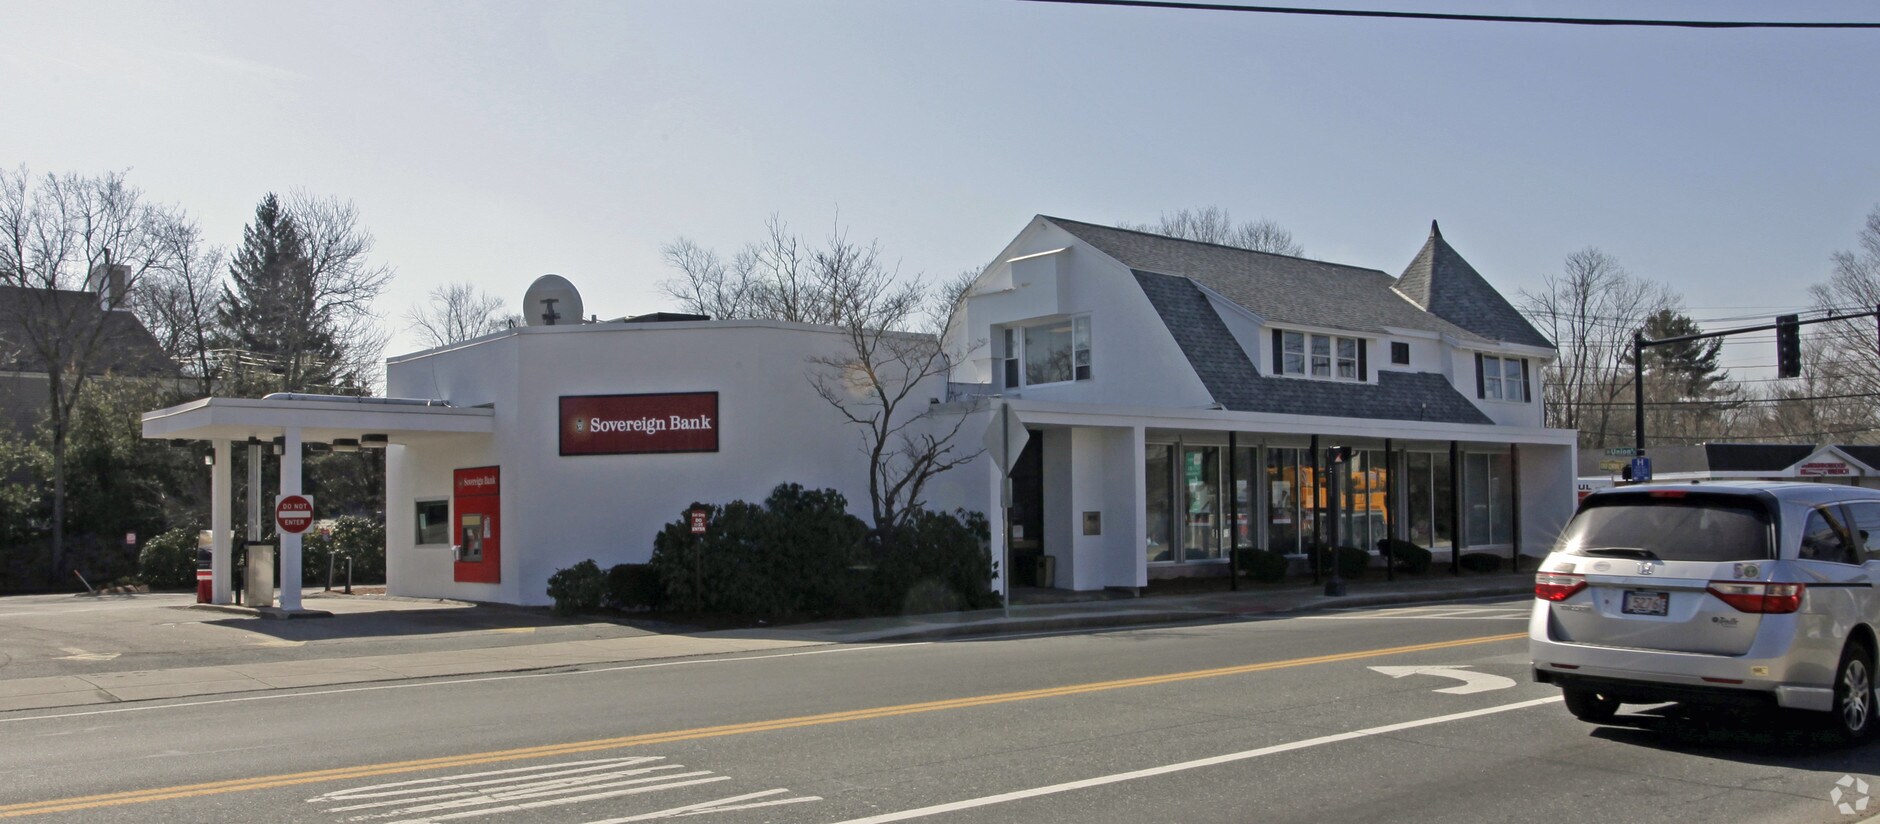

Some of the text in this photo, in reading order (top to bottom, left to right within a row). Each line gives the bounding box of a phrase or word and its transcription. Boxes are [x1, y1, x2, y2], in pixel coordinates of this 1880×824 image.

[590, 414, 712, 434] Sovereign Bank
[463, 475, 496, 489] Sovereign Bank
